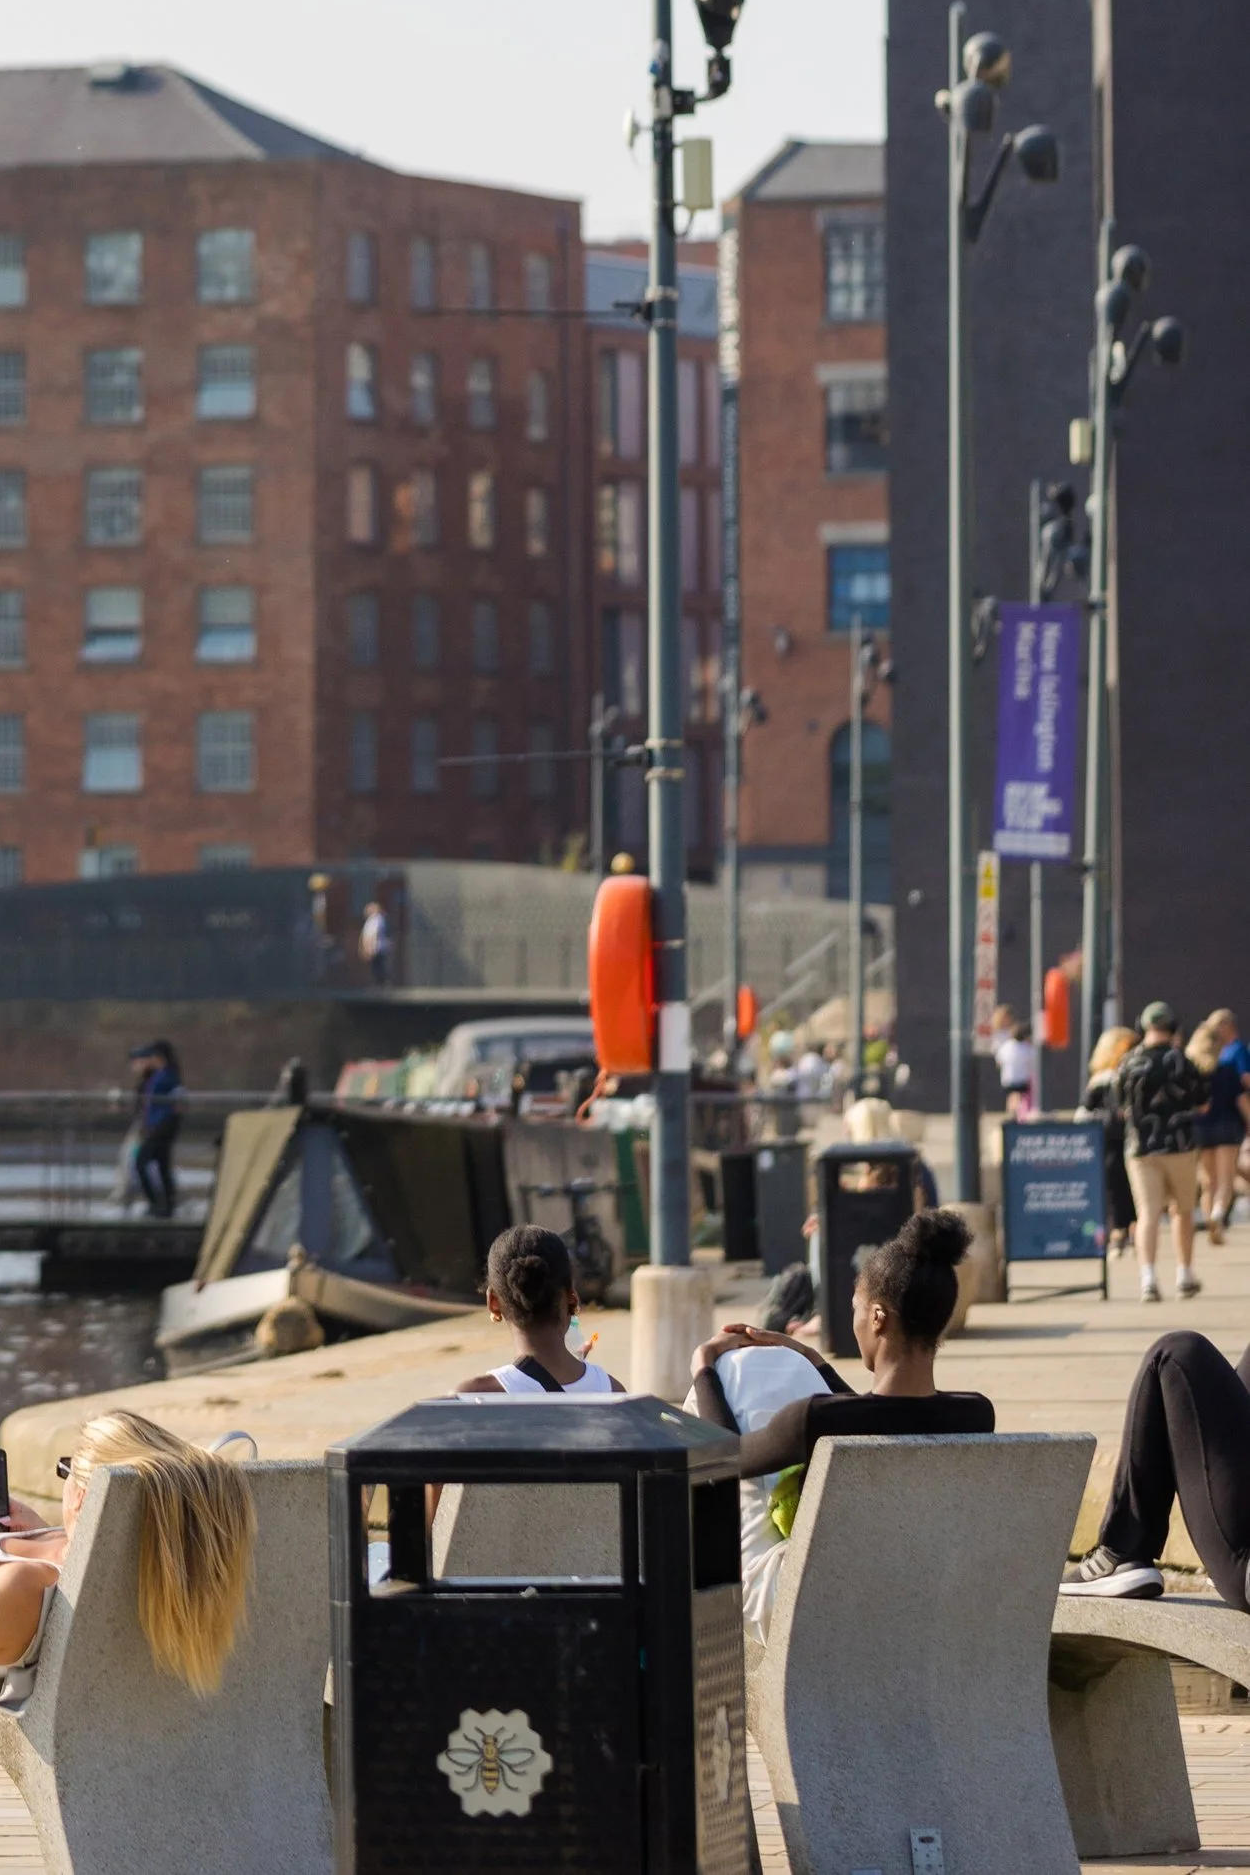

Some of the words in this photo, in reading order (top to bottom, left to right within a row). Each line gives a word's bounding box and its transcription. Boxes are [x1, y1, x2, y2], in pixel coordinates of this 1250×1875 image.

[1014, 621, 1037, 701] Marina
[1039, 621, 1061, 671] New
[1033, 674, 1061, 772] Islington
